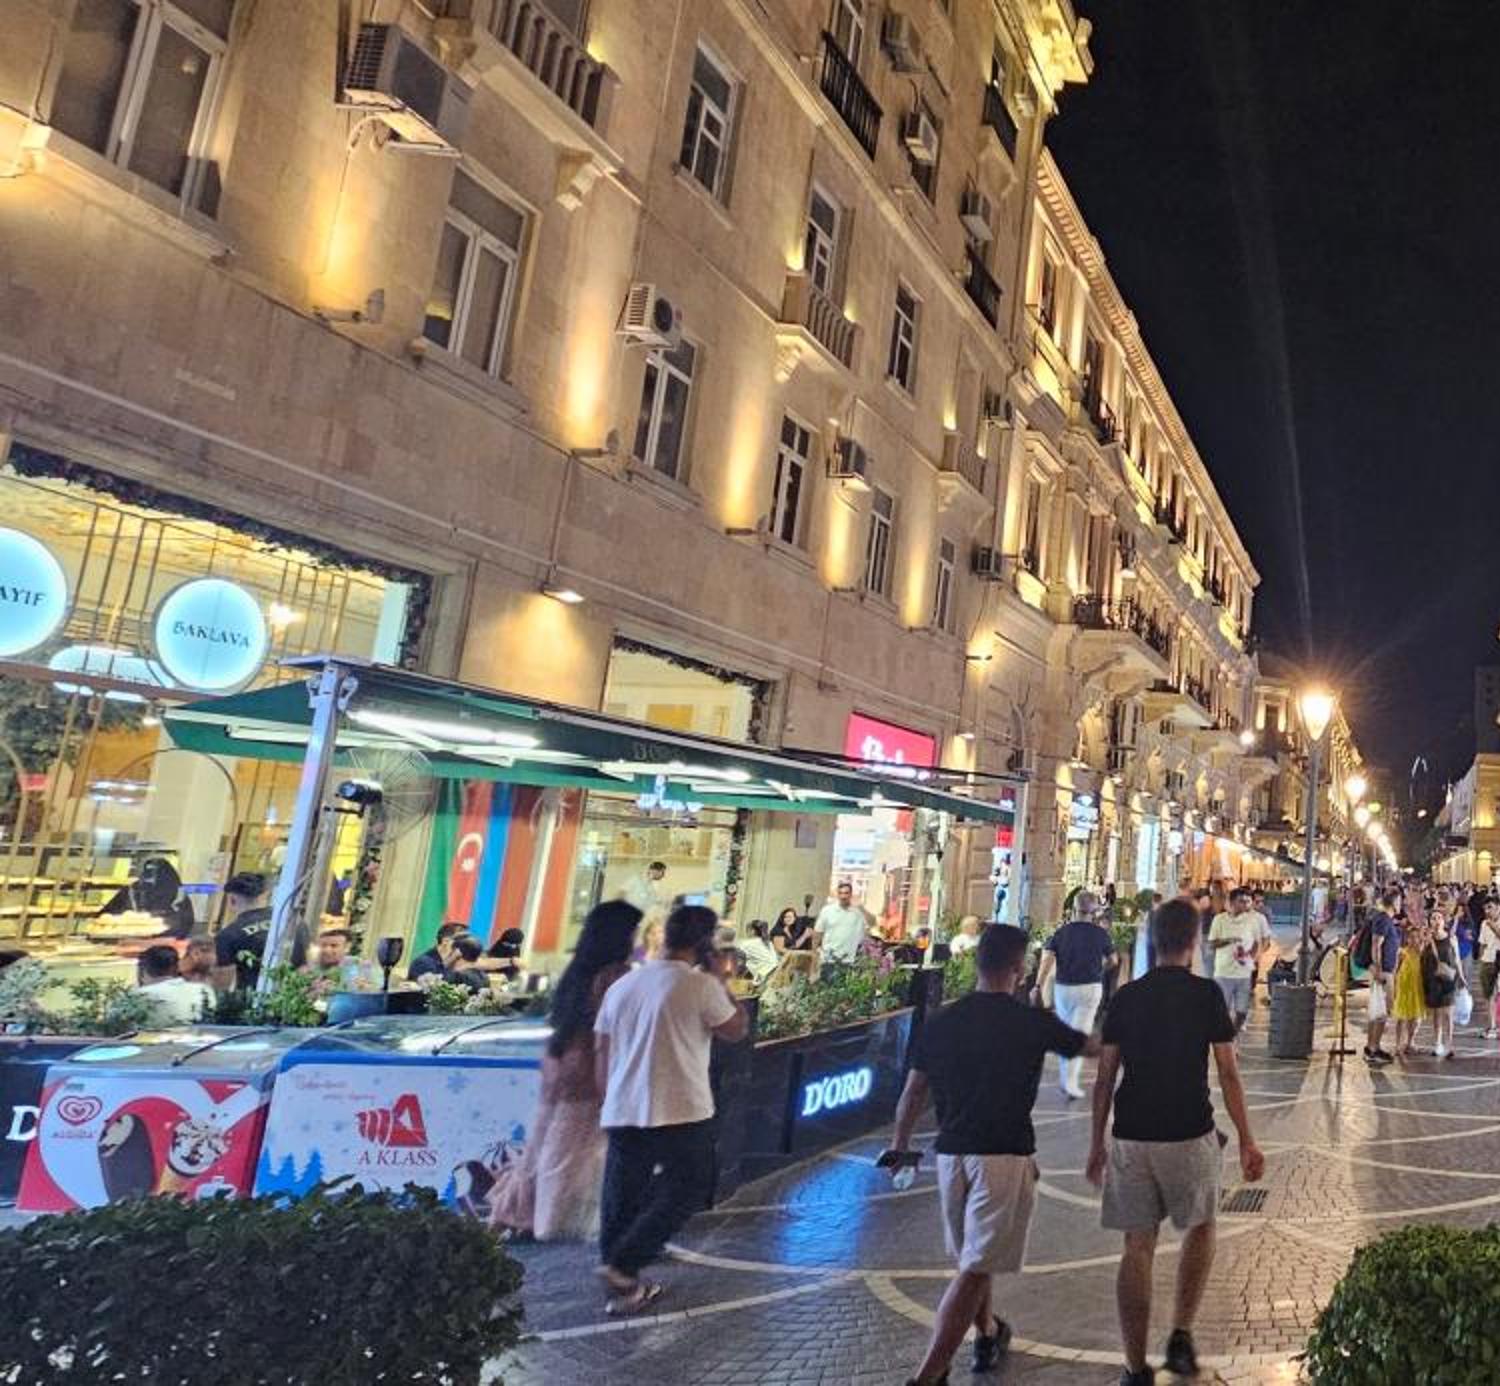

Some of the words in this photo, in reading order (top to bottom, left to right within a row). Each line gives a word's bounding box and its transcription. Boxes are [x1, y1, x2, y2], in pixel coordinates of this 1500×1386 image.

[173, 620, 250, 649] BAKLAVA
[801, 1067, 873, 1116] D'ORO
[357, 1150, 371, 1165] A
[376, 1149, 438, 1166] KLASS
